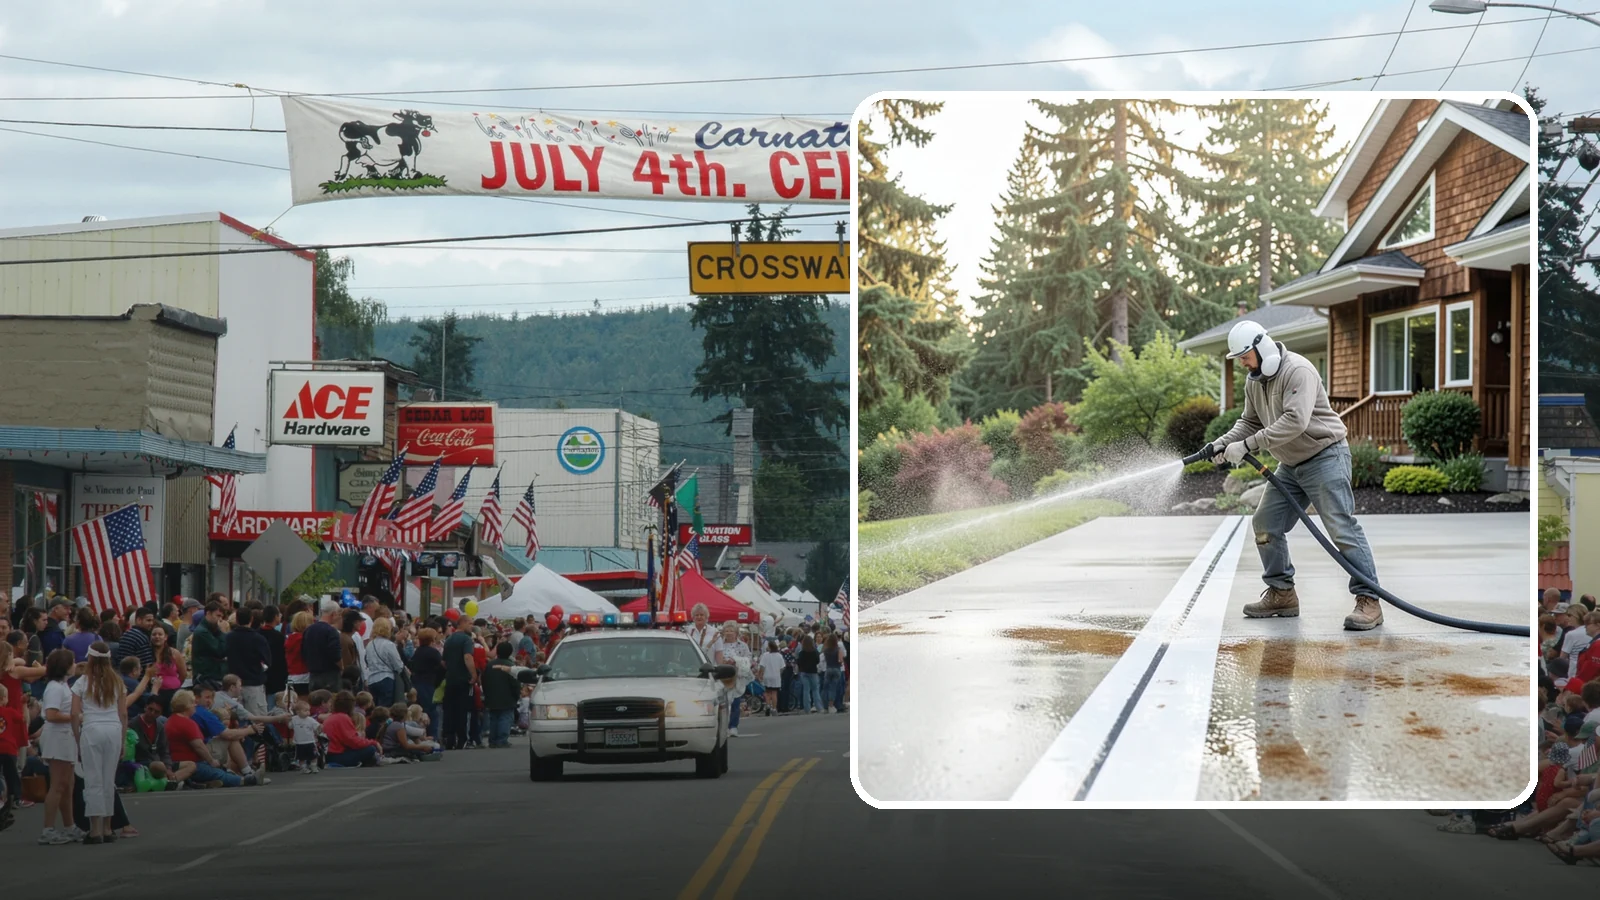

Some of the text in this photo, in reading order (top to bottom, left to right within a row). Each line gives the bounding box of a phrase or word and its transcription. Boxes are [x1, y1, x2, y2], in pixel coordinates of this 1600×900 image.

[481, 140, 605, 192] JULY
[632, 150, 747, 198] 4th.
[696, 253, 850, 280] CROSSWA
[283, 380, 373, 420] ACE
[405, 408, 486, 422] CEDAR LOG
[283, 421, 371, 437] Hardware
[83, 484, 155, 495] St. Vincent de Paul
[688, 526, 742, 535] CRNATION
[699, 535, 731, 543] GLASS
